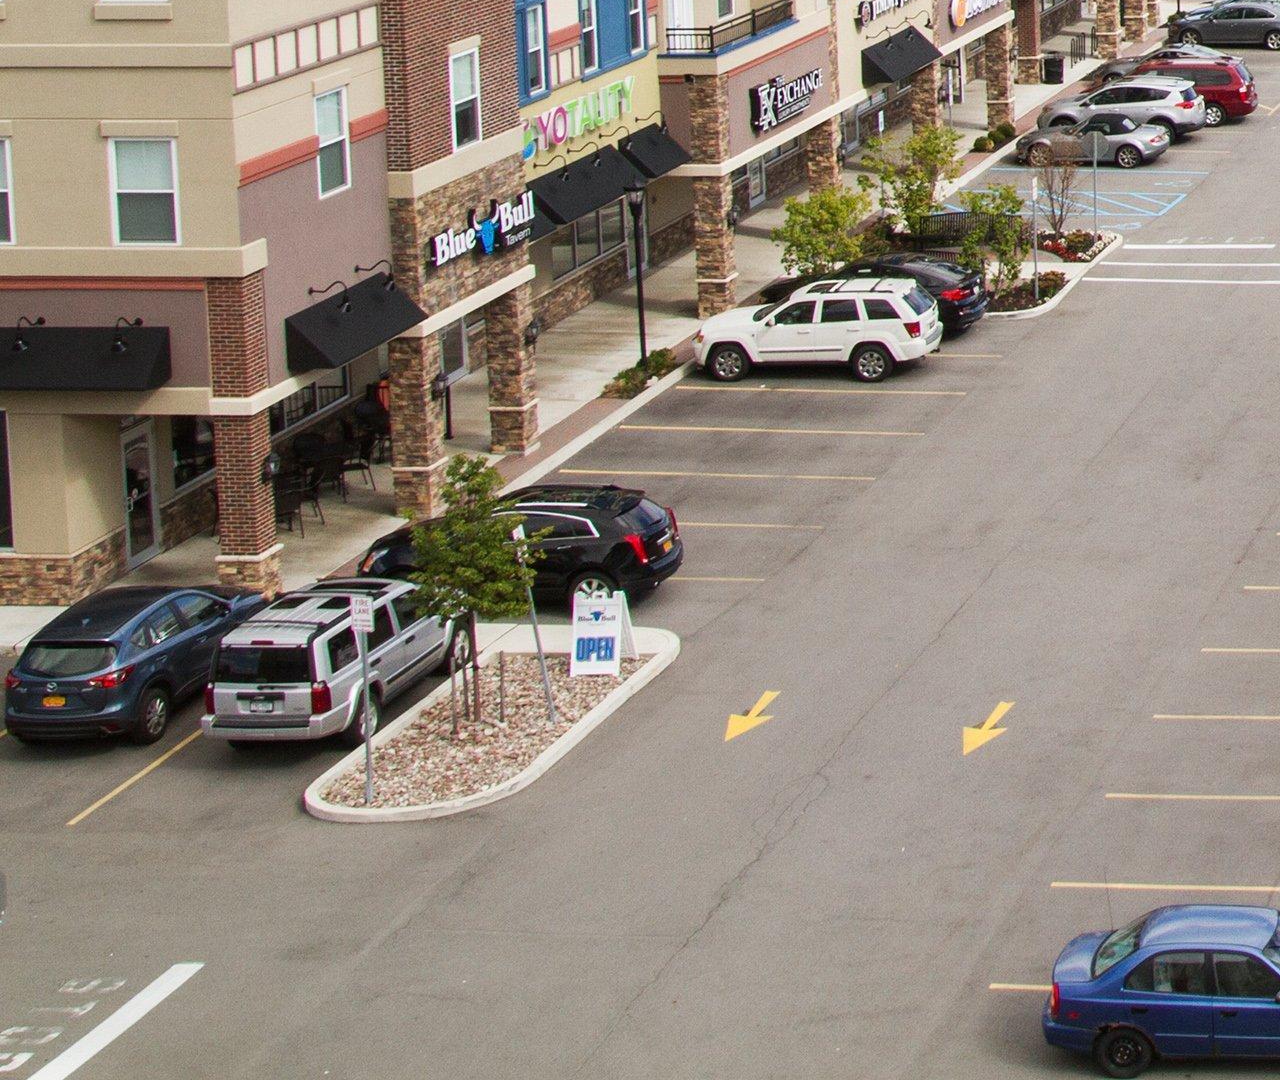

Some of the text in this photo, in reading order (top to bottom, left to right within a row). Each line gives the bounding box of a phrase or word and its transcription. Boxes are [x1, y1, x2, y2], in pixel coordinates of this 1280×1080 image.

[776, 68, 823, 108] EXCHANGE
[533, 76, 636, 151] YOTALITY
[434, 189, 536, 267] Blue Bull
[505, 227, 531, 246] Tavern
[576, 636, 615, 662] OPEN
